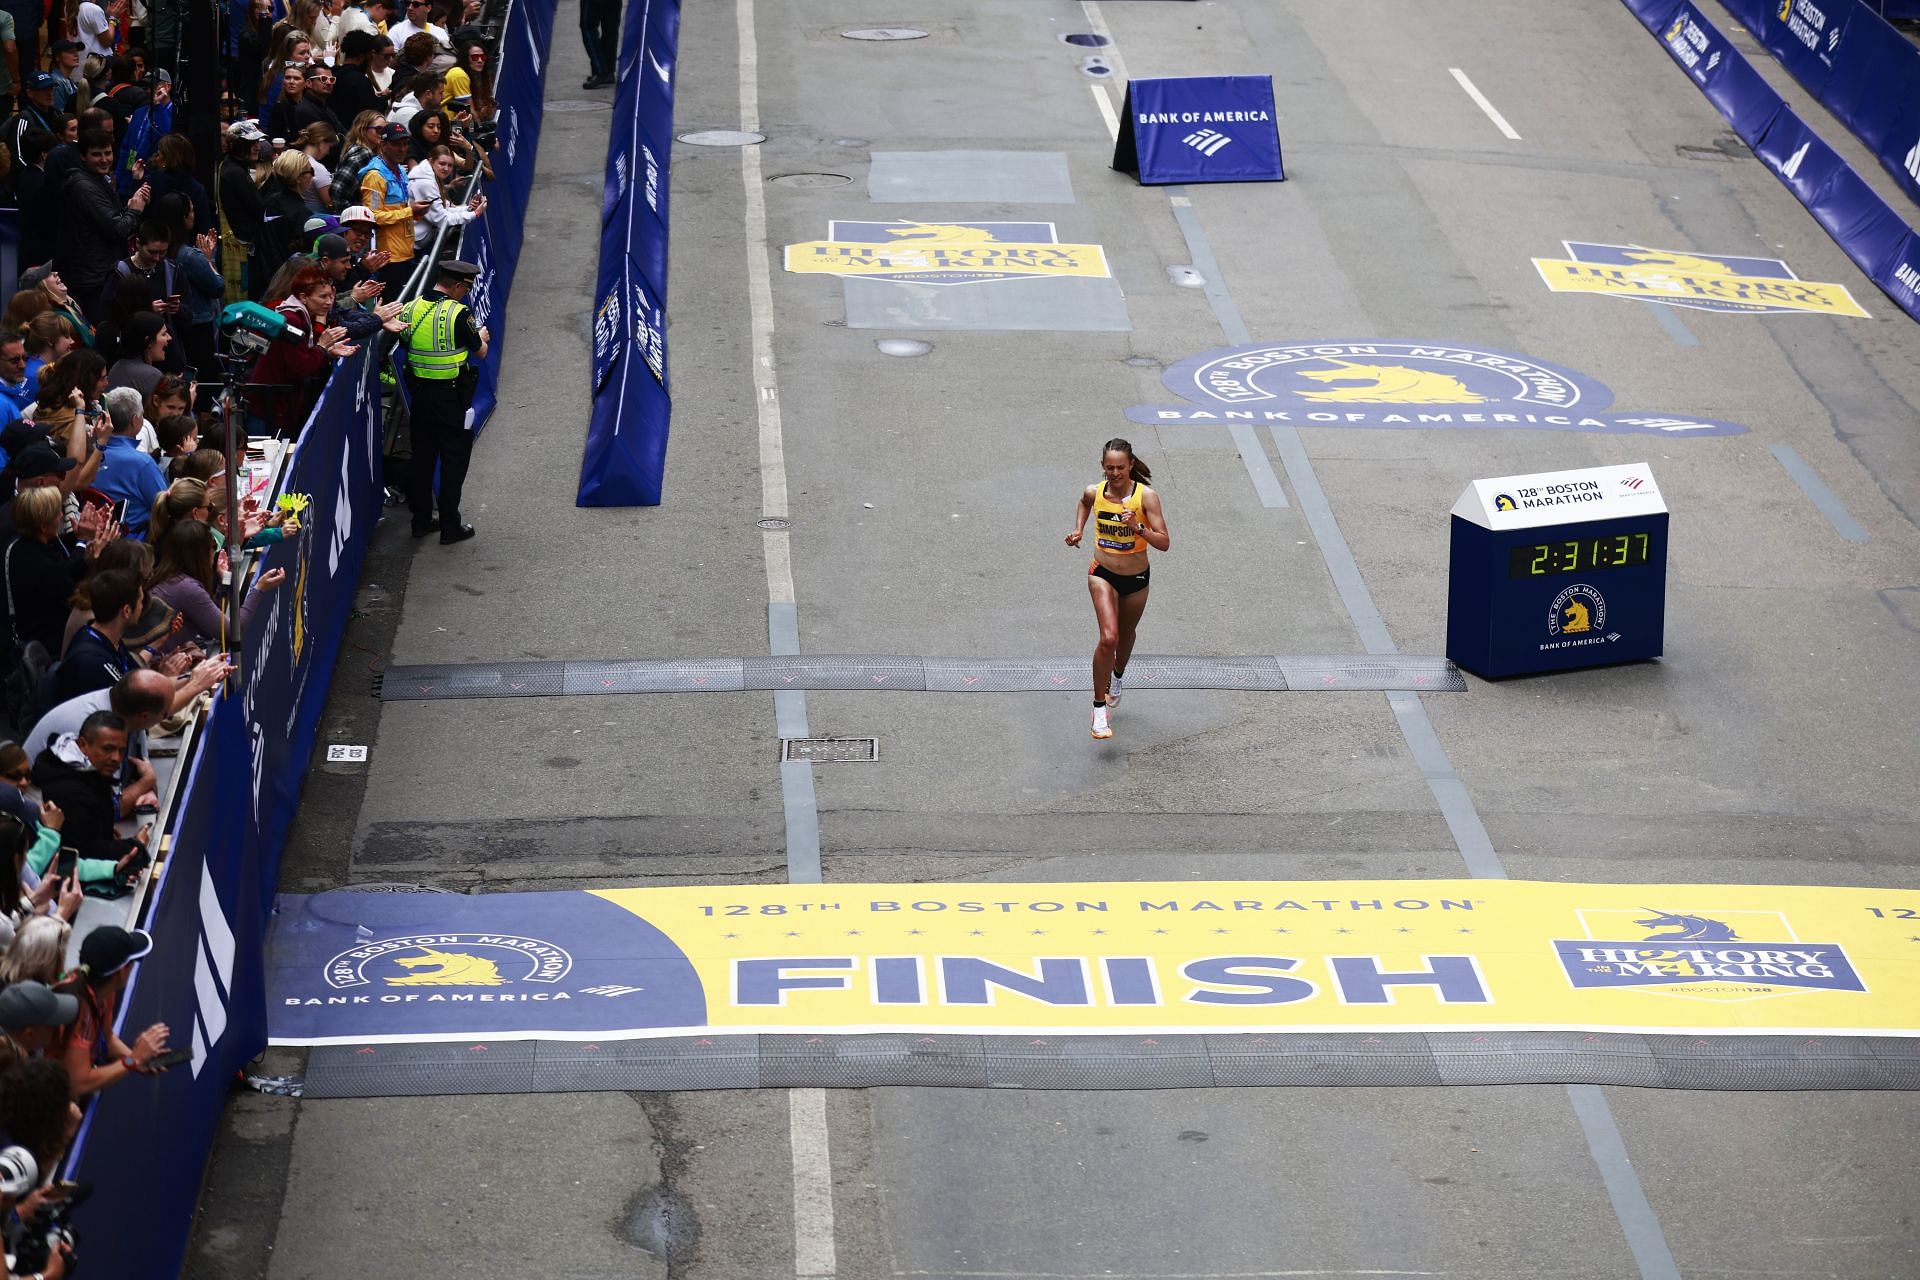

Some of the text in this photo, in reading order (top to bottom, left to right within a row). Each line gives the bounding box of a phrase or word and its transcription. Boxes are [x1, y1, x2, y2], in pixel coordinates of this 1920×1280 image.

[1139, 110, 1269, 124] BANK OF AMERICA
[438, 309, 447, 351] POLICE
[1222, 346, 1377, 370] BOSTON
[1409, 348, 1567, 402] MARATHON
[1157, 410, 1607, 427] BANK OF AMERICA
[1546, 480, 1599, 495] BOSTON
[1522, 490, 1604, 509] MARATHON
[1531, 533, 1649, 575] 2:31:37
[1553, 586, 1579, 610] BOSTON
[1582, 586, 1604, 624] MARATHON
[1540, 637, 1605, 651] BANK OF AMERICA
[698, 900, 1474, 917] 128TH BOSTON MARATHON
[350, 936, 458, 959] BOSTON
[477, 936, 563, 979] MARATHON
[734, 955, 1491, 1006] FINISH
[285, 991, 571, 1006] BANK OF AMERICA
